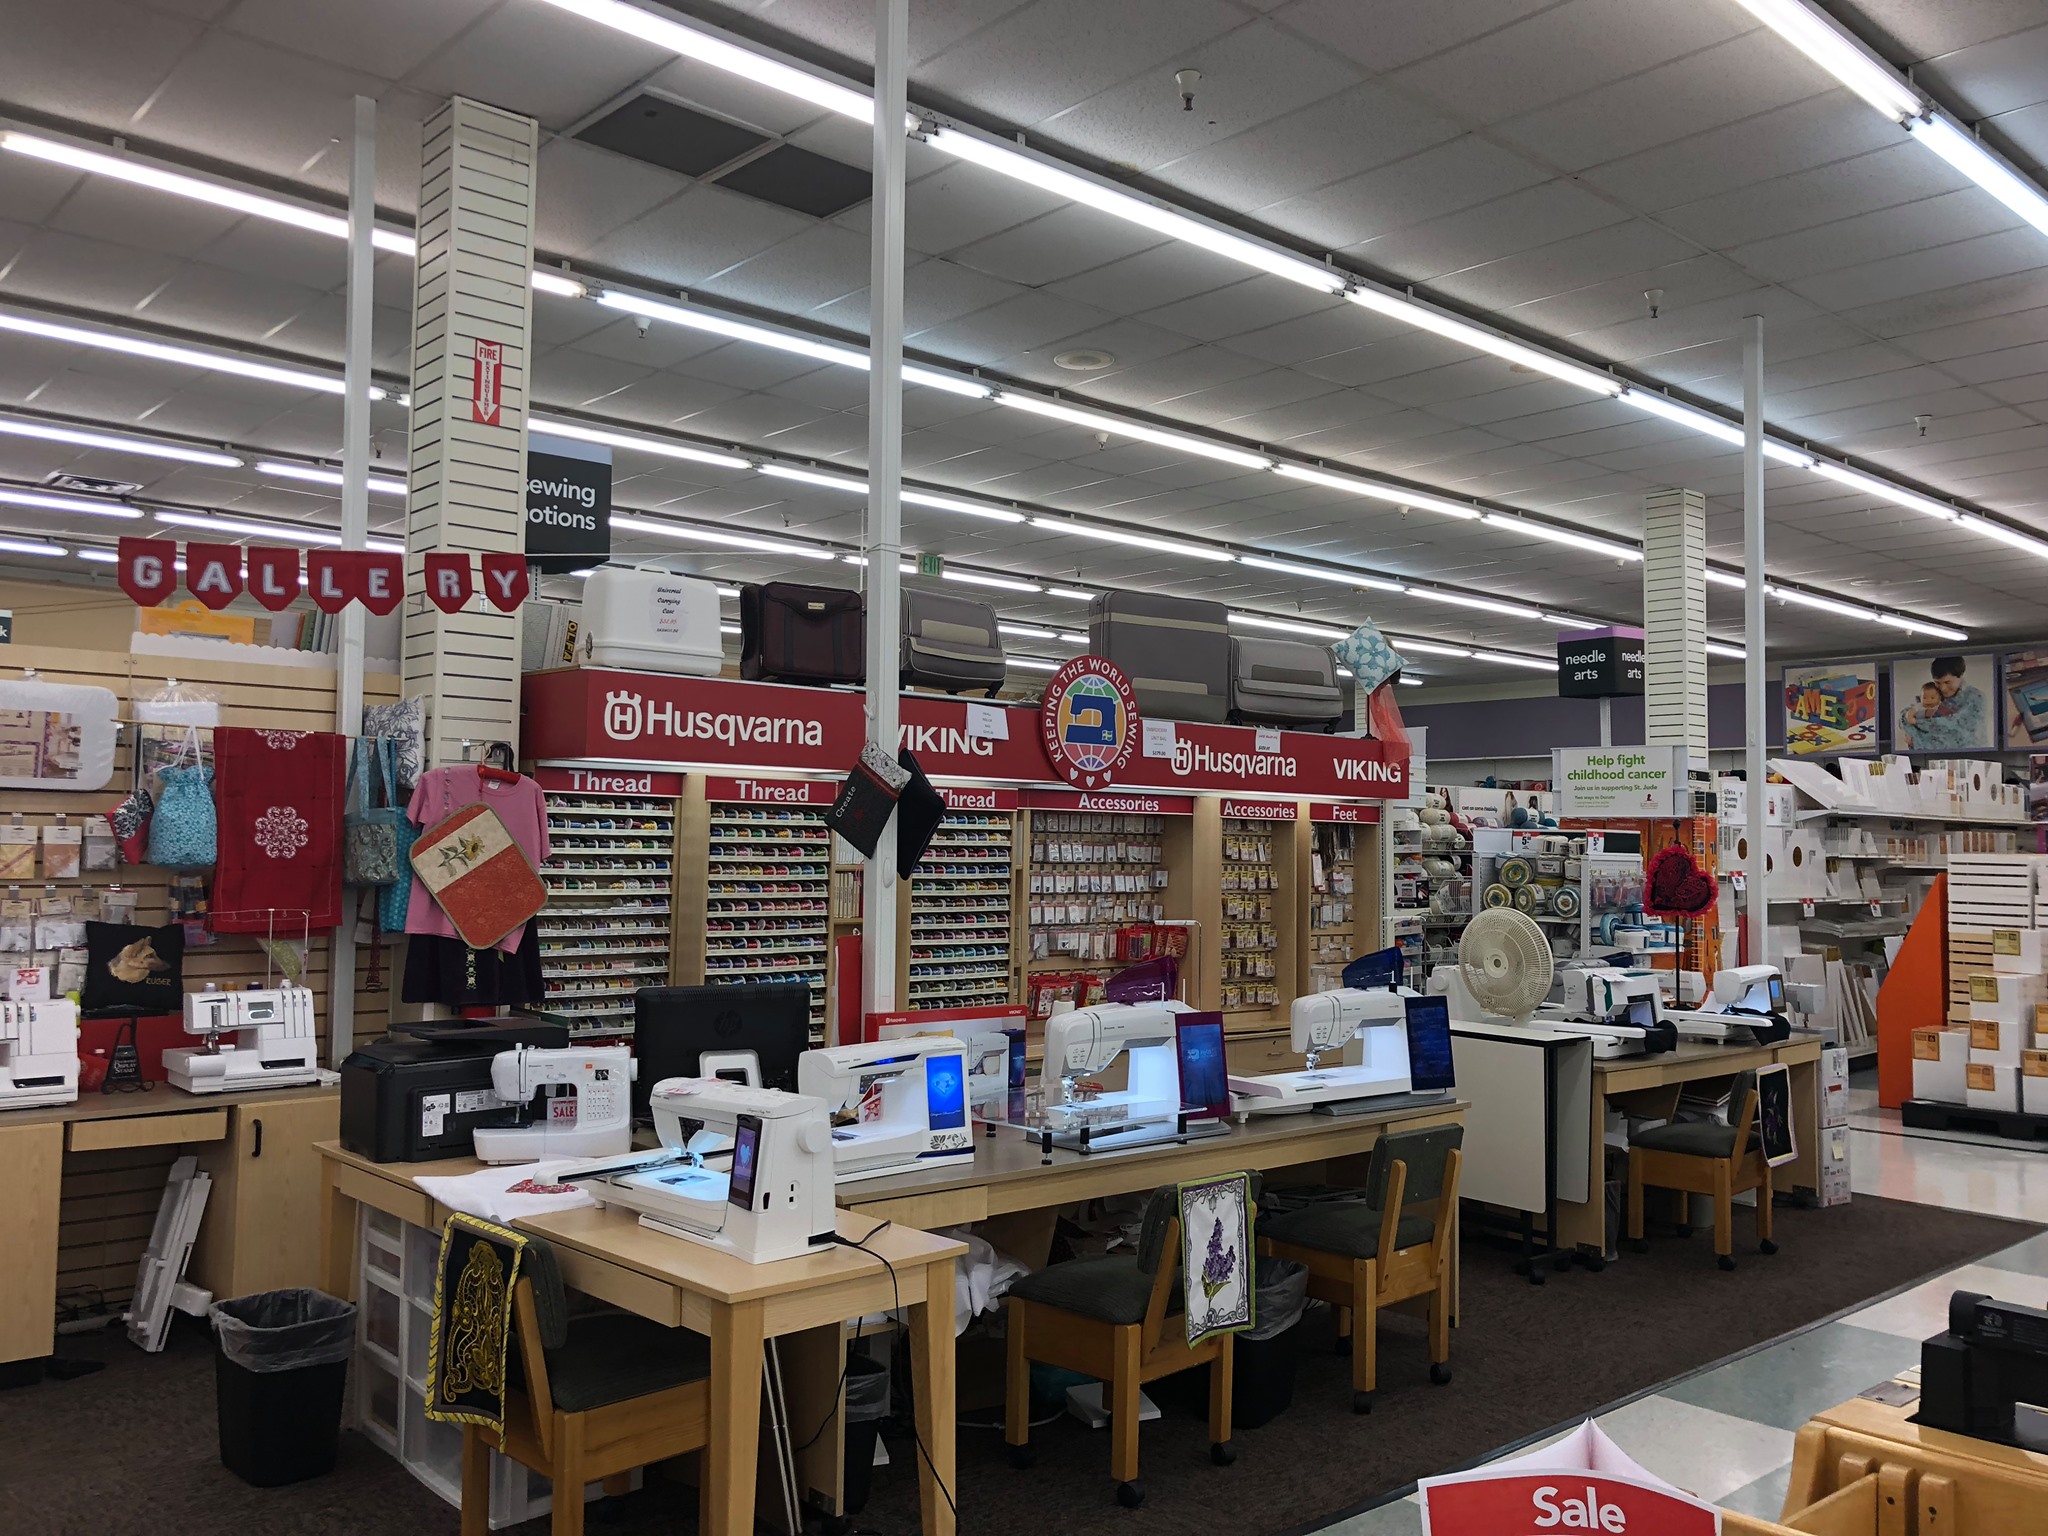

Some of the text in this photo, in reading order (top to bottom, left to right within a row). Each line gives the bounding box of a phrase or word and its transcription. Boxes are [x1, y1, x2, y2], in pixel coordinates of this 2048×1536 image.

[480, 346, 498, 361] FIRE
[525, 504, 597, 531] otions
[562, 619, 579, 663] OLFA
[1565, 650, 1606, 665] needle
[1574, 668, 1598, 681] arts
[1627, 668, 1642, 679] arts
[1046, 658, 1138, 769] KEEPING THE WORLD SEWING
[1785, 683, 1849, 730] GAMES
[647, 699, 823, 747] Husqvarna
[1194, 744, 1297, 779] Husqvarna
[1333, 757, 1402, 783] VIKING
[1587, 754, 1646, 768] Help fight
[568, 769, 652, 793] Thread
[1567, 769, 1666, 781] childhood cancer
[735, 779, 809, 802] Thread
[935, 788, 996, 808] Thread
[835, 786, 856, 818] Create
[1078, 792, 1160, 811] Accessories
[1223, 800, 1295, 819] Accessories
[1332, 805, 1358, 821] Feet
[553, 1106, 577, 1118] SALE!
[1532, 1486, 1627, 1534] Sale
